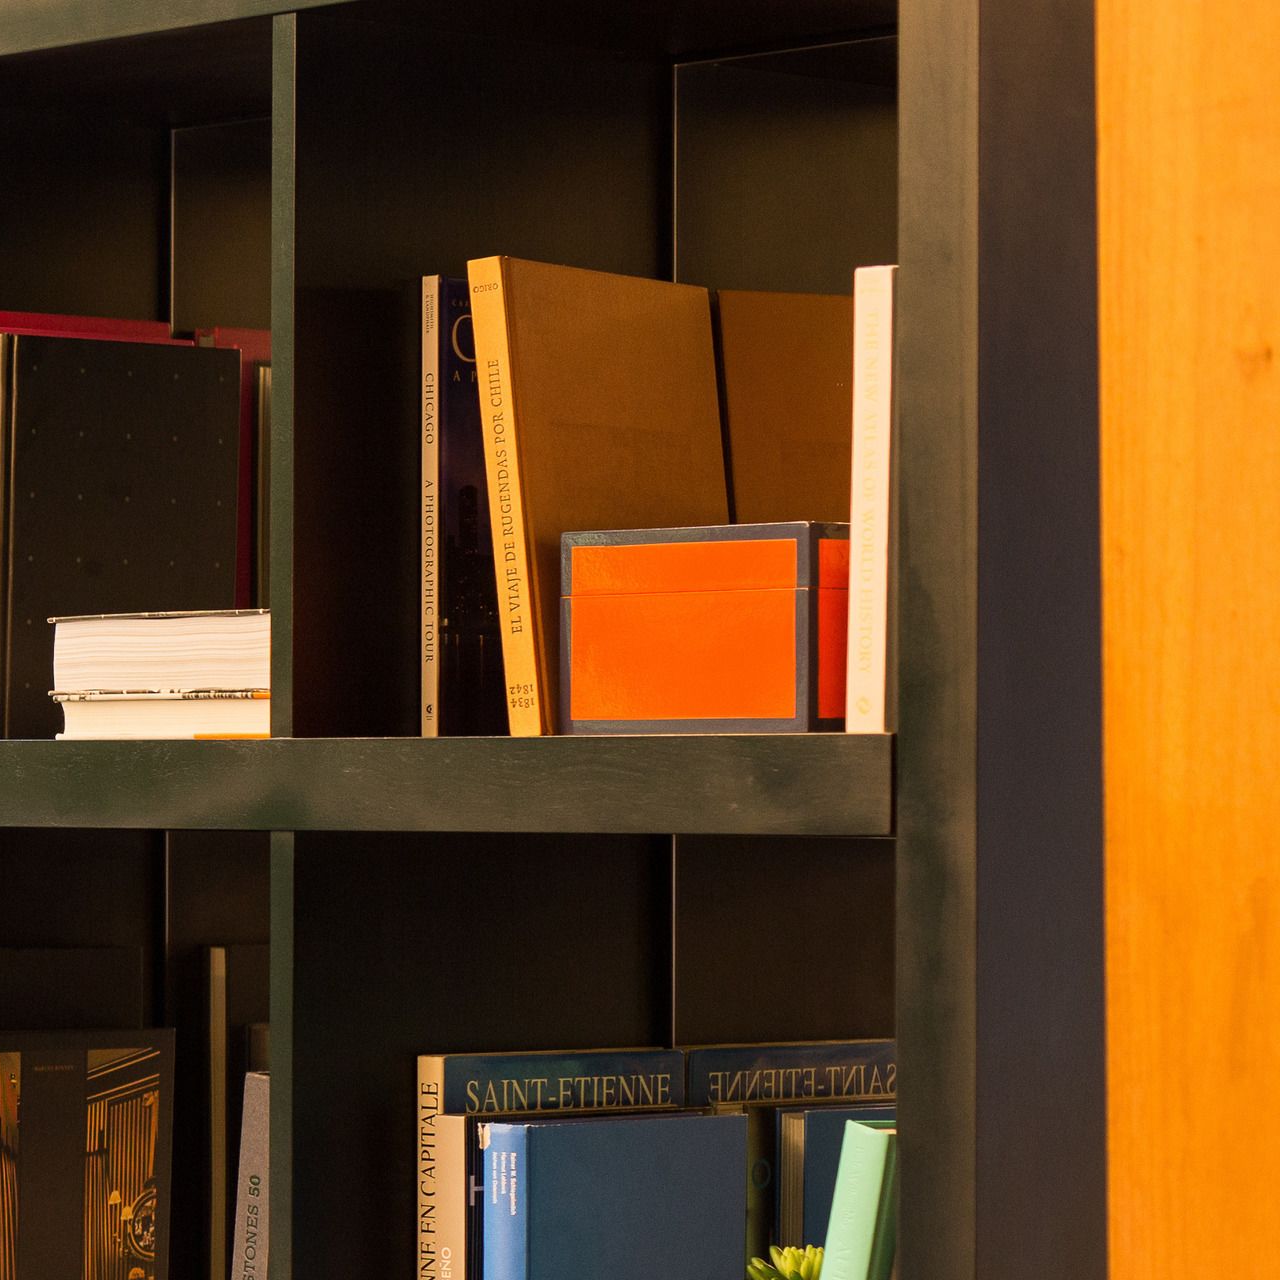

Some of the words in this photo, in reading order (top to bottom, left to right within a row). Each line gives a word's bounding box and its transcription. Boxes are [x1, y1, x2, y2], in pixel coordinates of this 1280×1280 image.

[473, 282, 499, 293] ORIGO
[864, 310, 879, 350] THE
[486, 359, 504, 408] CHILE
[863, 358, 879, 401] NEW
[424, 372, 435, 445] CHICAGO
[490, 412, 506, 445] POR
[862, 410, 877, 473] ATLAS
[425, 480, 434, 489] A
[494, 449, 515, 538] RUGENDAS
[861, 478, 876, 501] OF
[424, 494, 435, 617] PHOTOGRAPHIC
[503, 542, 516, 563] DE
[860, 508, 875, 583] WORLD
[506, 567, 522, 611] VIAJE
[424, 621, 434, 664] TOUR
[510, 615, 523, 634] EL
[858, 589, 873, 674] HISTORY
[509, 684, 533, 695] 1842
[510, 697, 535, 708] 1834
[466, 1072, 670, 1113] SAINT-ETIENNE
[419, 1081, 439, 1198] CAPITALE
[247, 1175, 261, 1198] 50
[420, 1212, 435, 1235] EN
